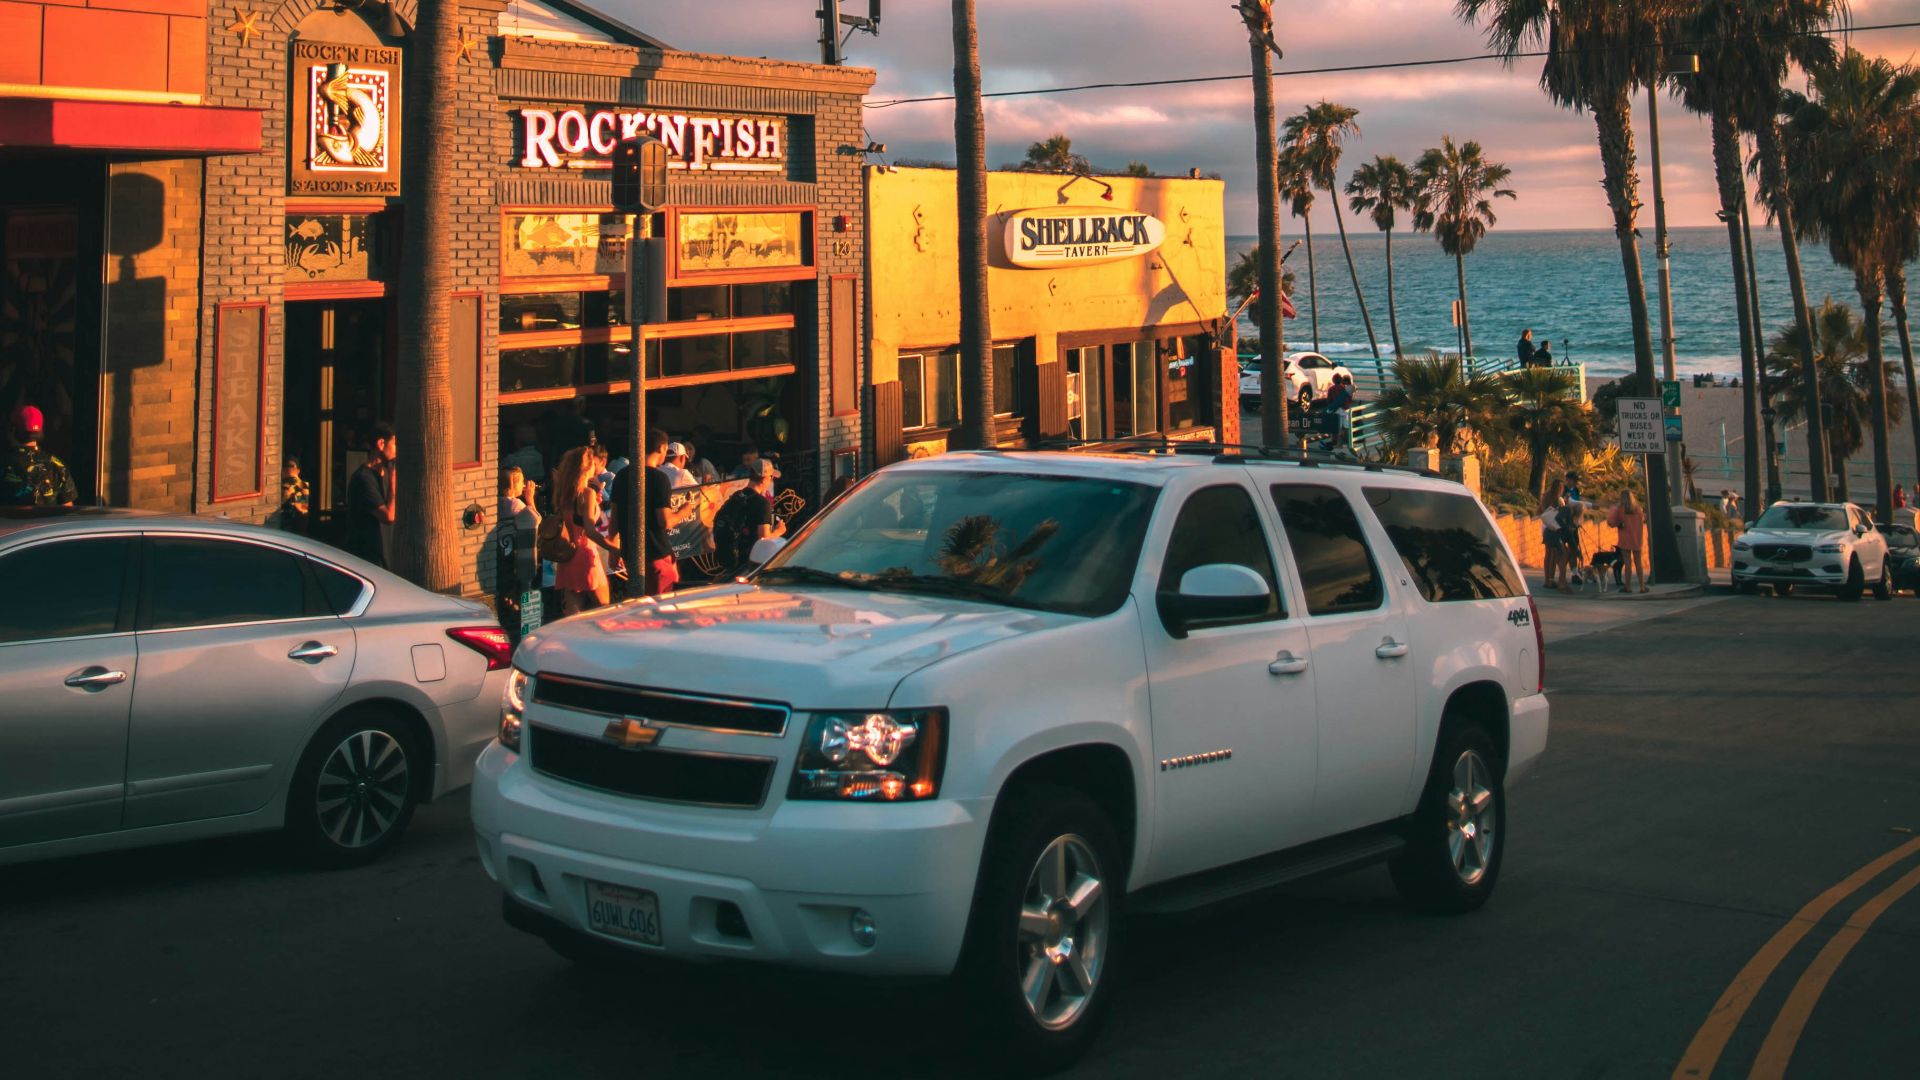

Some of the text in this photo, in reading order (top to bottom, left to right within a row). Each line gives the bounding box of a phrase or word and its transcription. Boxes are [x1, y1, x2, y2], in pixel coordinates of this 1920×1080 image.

[365, 49, 399, 65] FISH
[690, 117, 783, 171] FISH
[1021, 215, 1150, 250] SHELLBACK
[835, 241, 851, 256] 120
[1065, 245, 1109, 257] TAVERN
[225, 326, 251, 475] STEAKS
[1633, 401, 1646, 410] NO
[1621, 412, 1660, 420] TRUCKS OR
[1629, 422, 1653, 430] BUSES
[1627, 432, 1657, 440] WEST OF
[1624, 441, 1647, 450] OCEAN
[592, 900, 656, 936] 6UWL606
